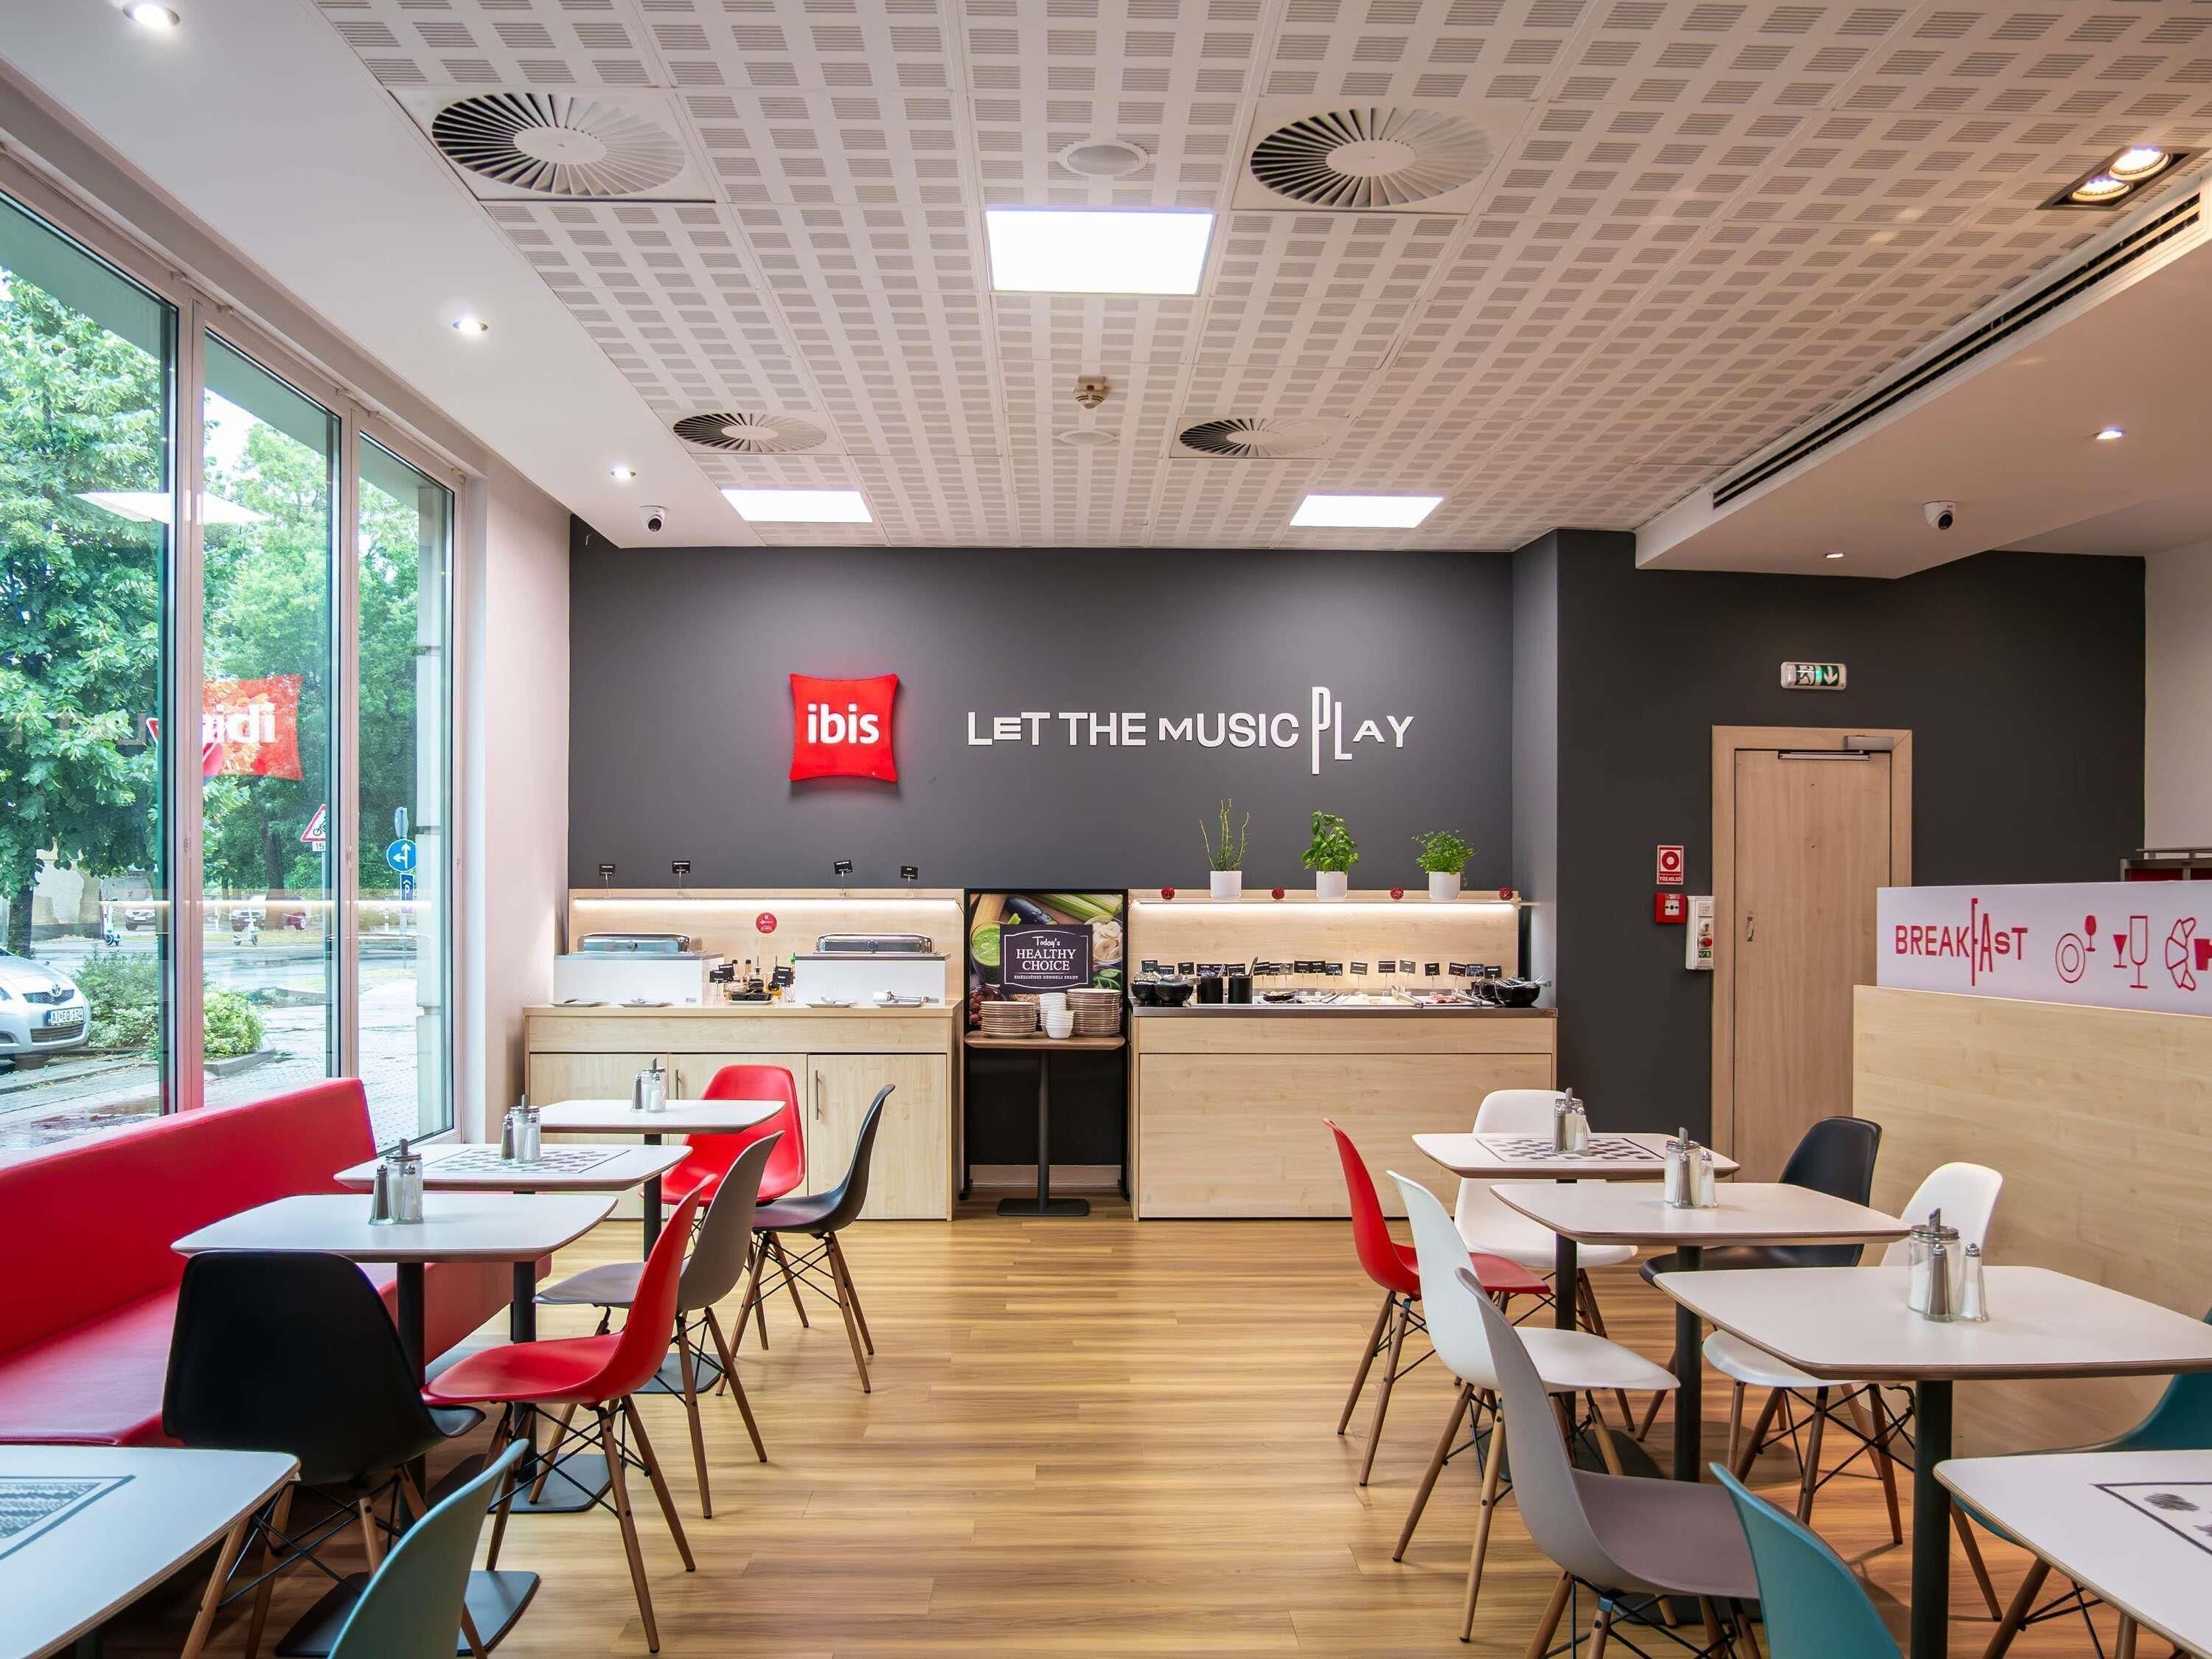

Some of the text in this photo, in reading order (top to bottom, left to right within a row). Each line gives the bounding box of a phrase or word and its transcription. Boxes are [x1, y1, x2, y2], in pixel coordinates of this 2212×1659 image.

[808, 704, 879, 743] ibis
[968, 686, 1413, 774] LET THE MUSIC PLAY
[1016, 949, 1076, 959] HEALTHY
[1032, 936, 1060, 948] Today's
[1895, 897, 2028, 987] BREAKFAST
[1023, 961, 1070, 970] CHOICE
